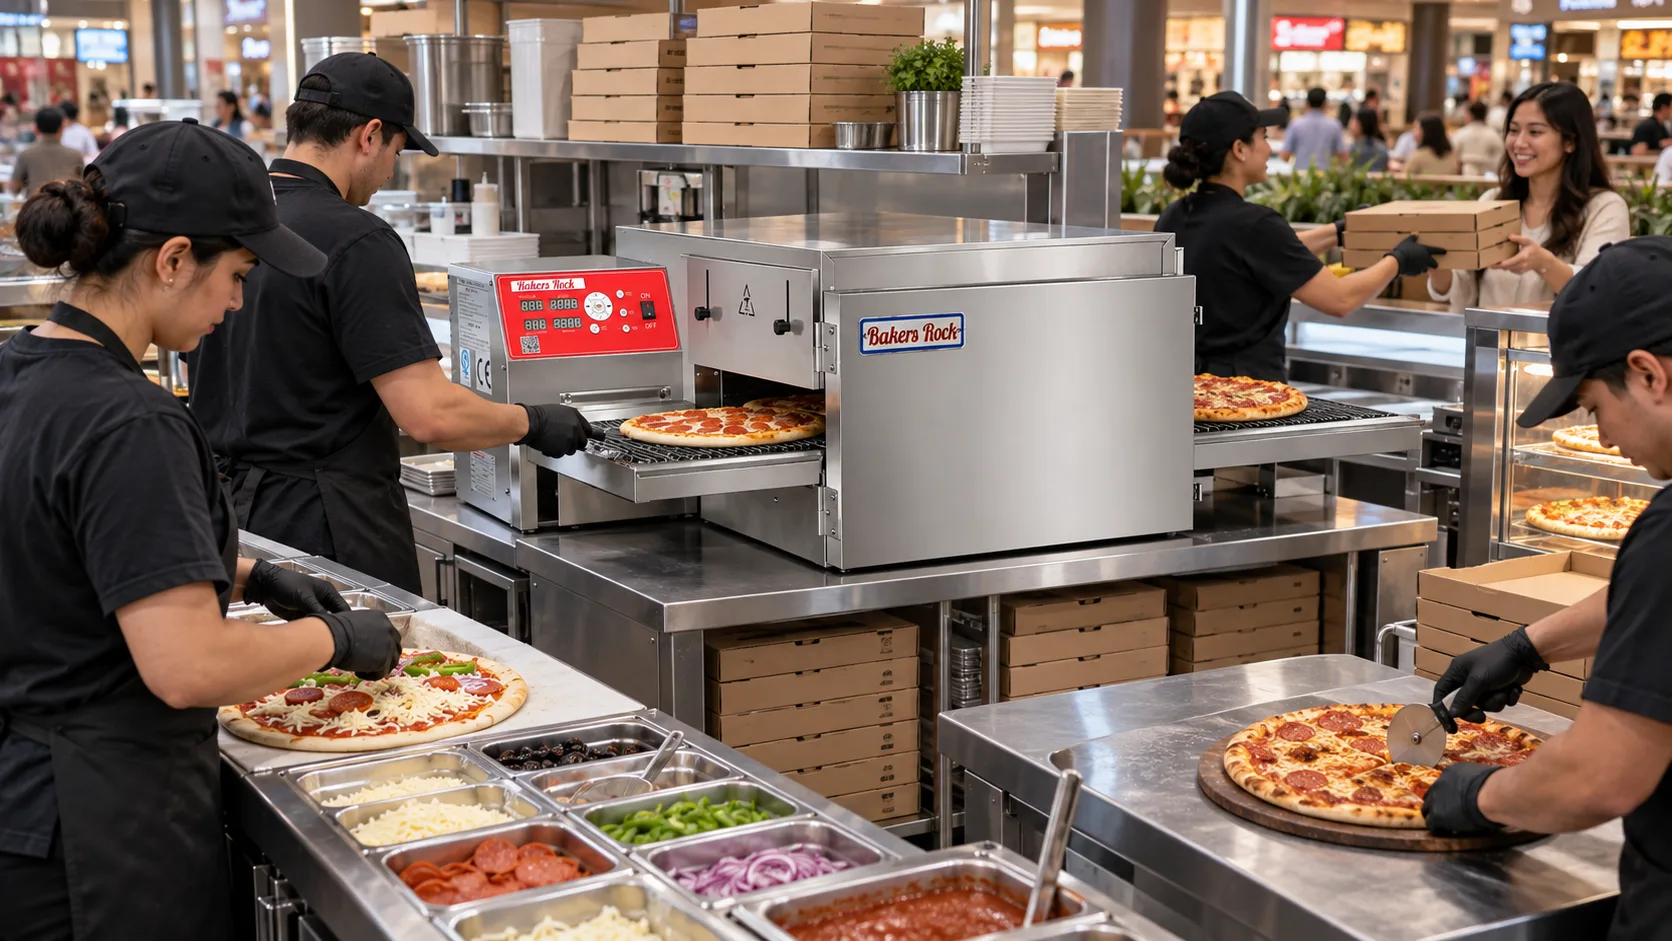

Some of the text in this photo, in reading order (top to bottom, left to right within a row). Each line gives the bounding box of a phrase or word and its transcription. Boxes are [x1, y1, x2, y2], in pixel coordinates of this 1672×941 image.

[867, 322, 958, 346] Bakers Rock
[476, 357, 492, 389] CE
